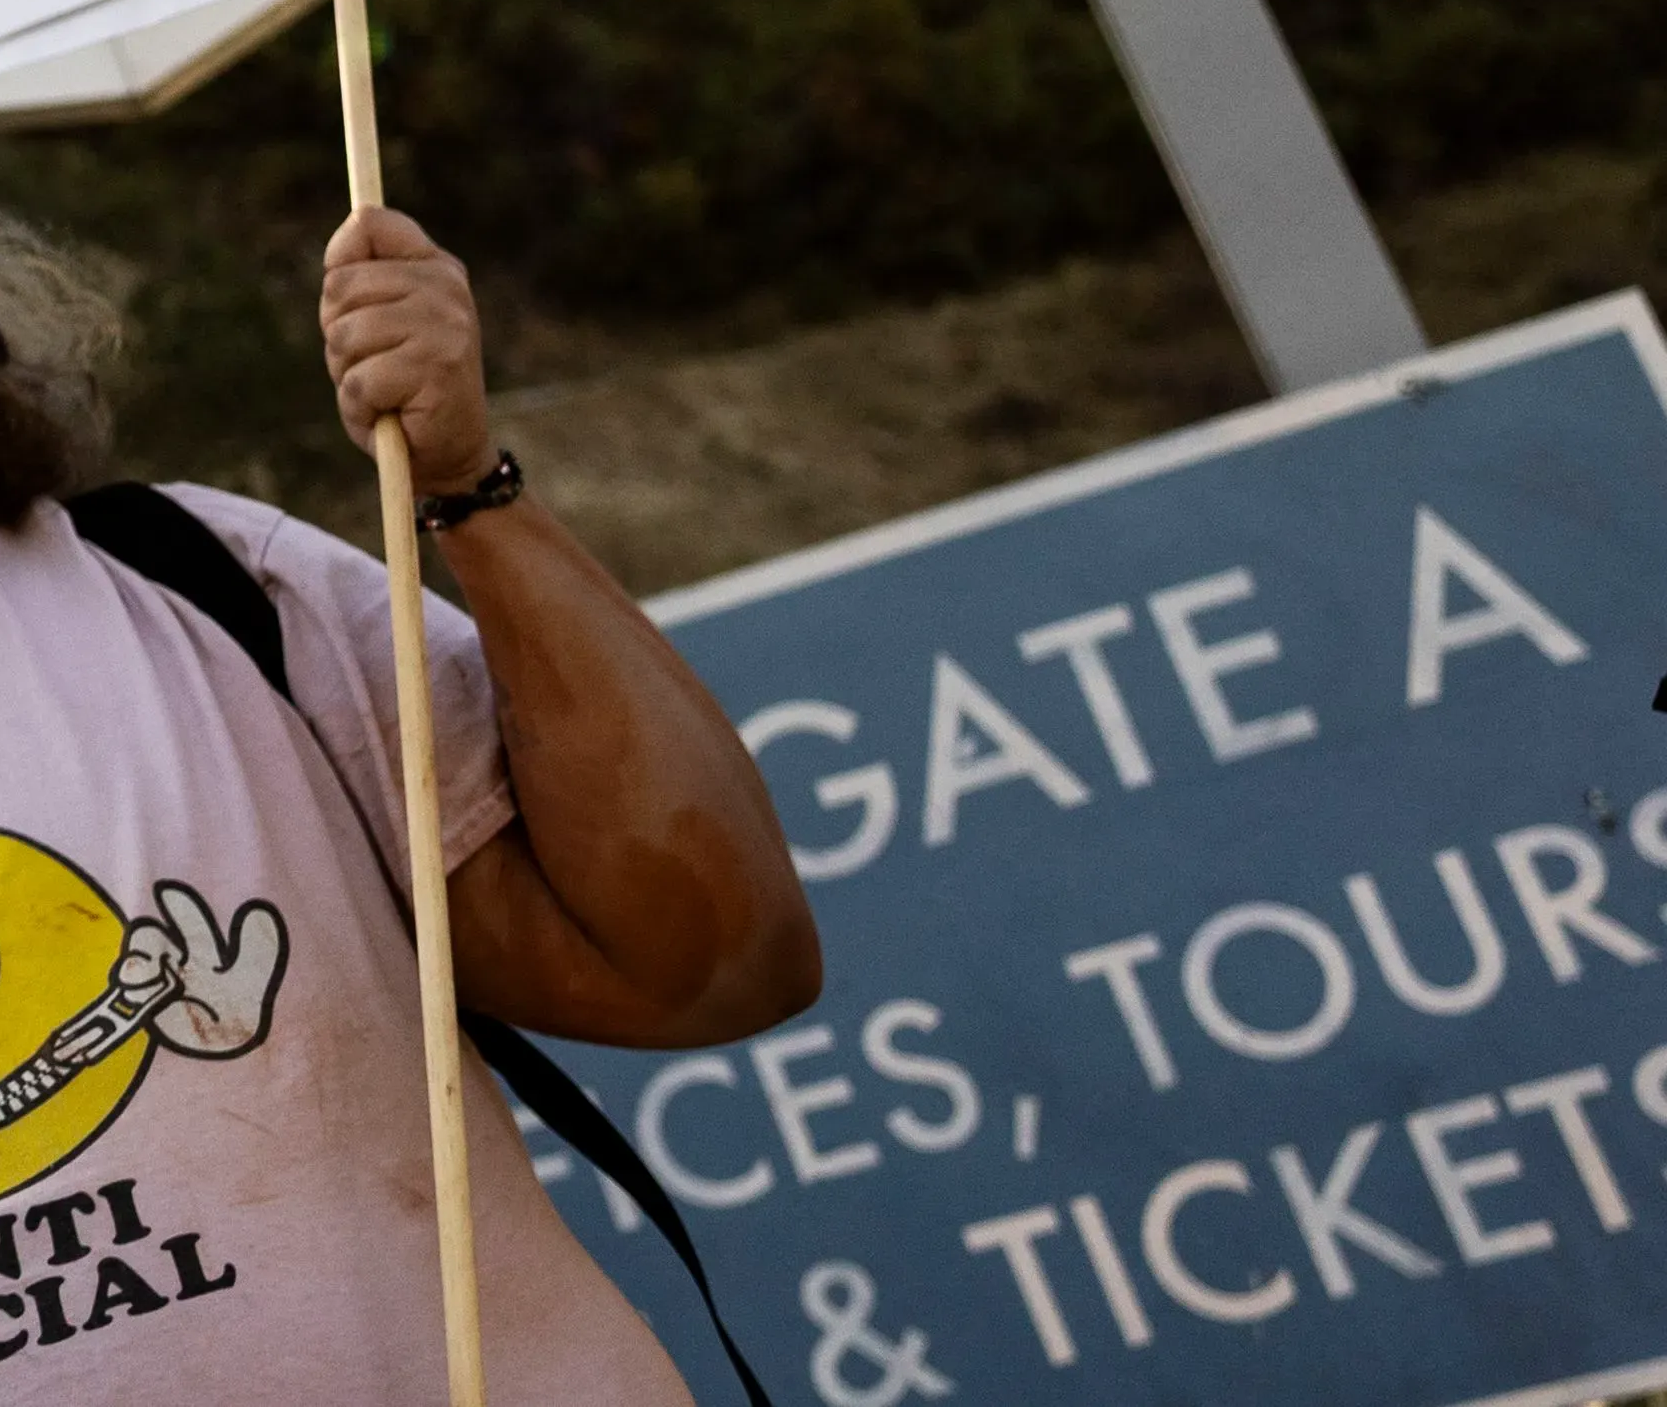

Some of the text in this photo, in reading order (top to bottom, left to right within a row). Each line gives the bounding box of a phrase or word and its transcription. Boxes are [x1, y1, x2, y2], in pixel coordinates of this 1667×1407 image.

[735, 504, 1591, 881] GATE A
[798, 1259, 956, 1407] &
